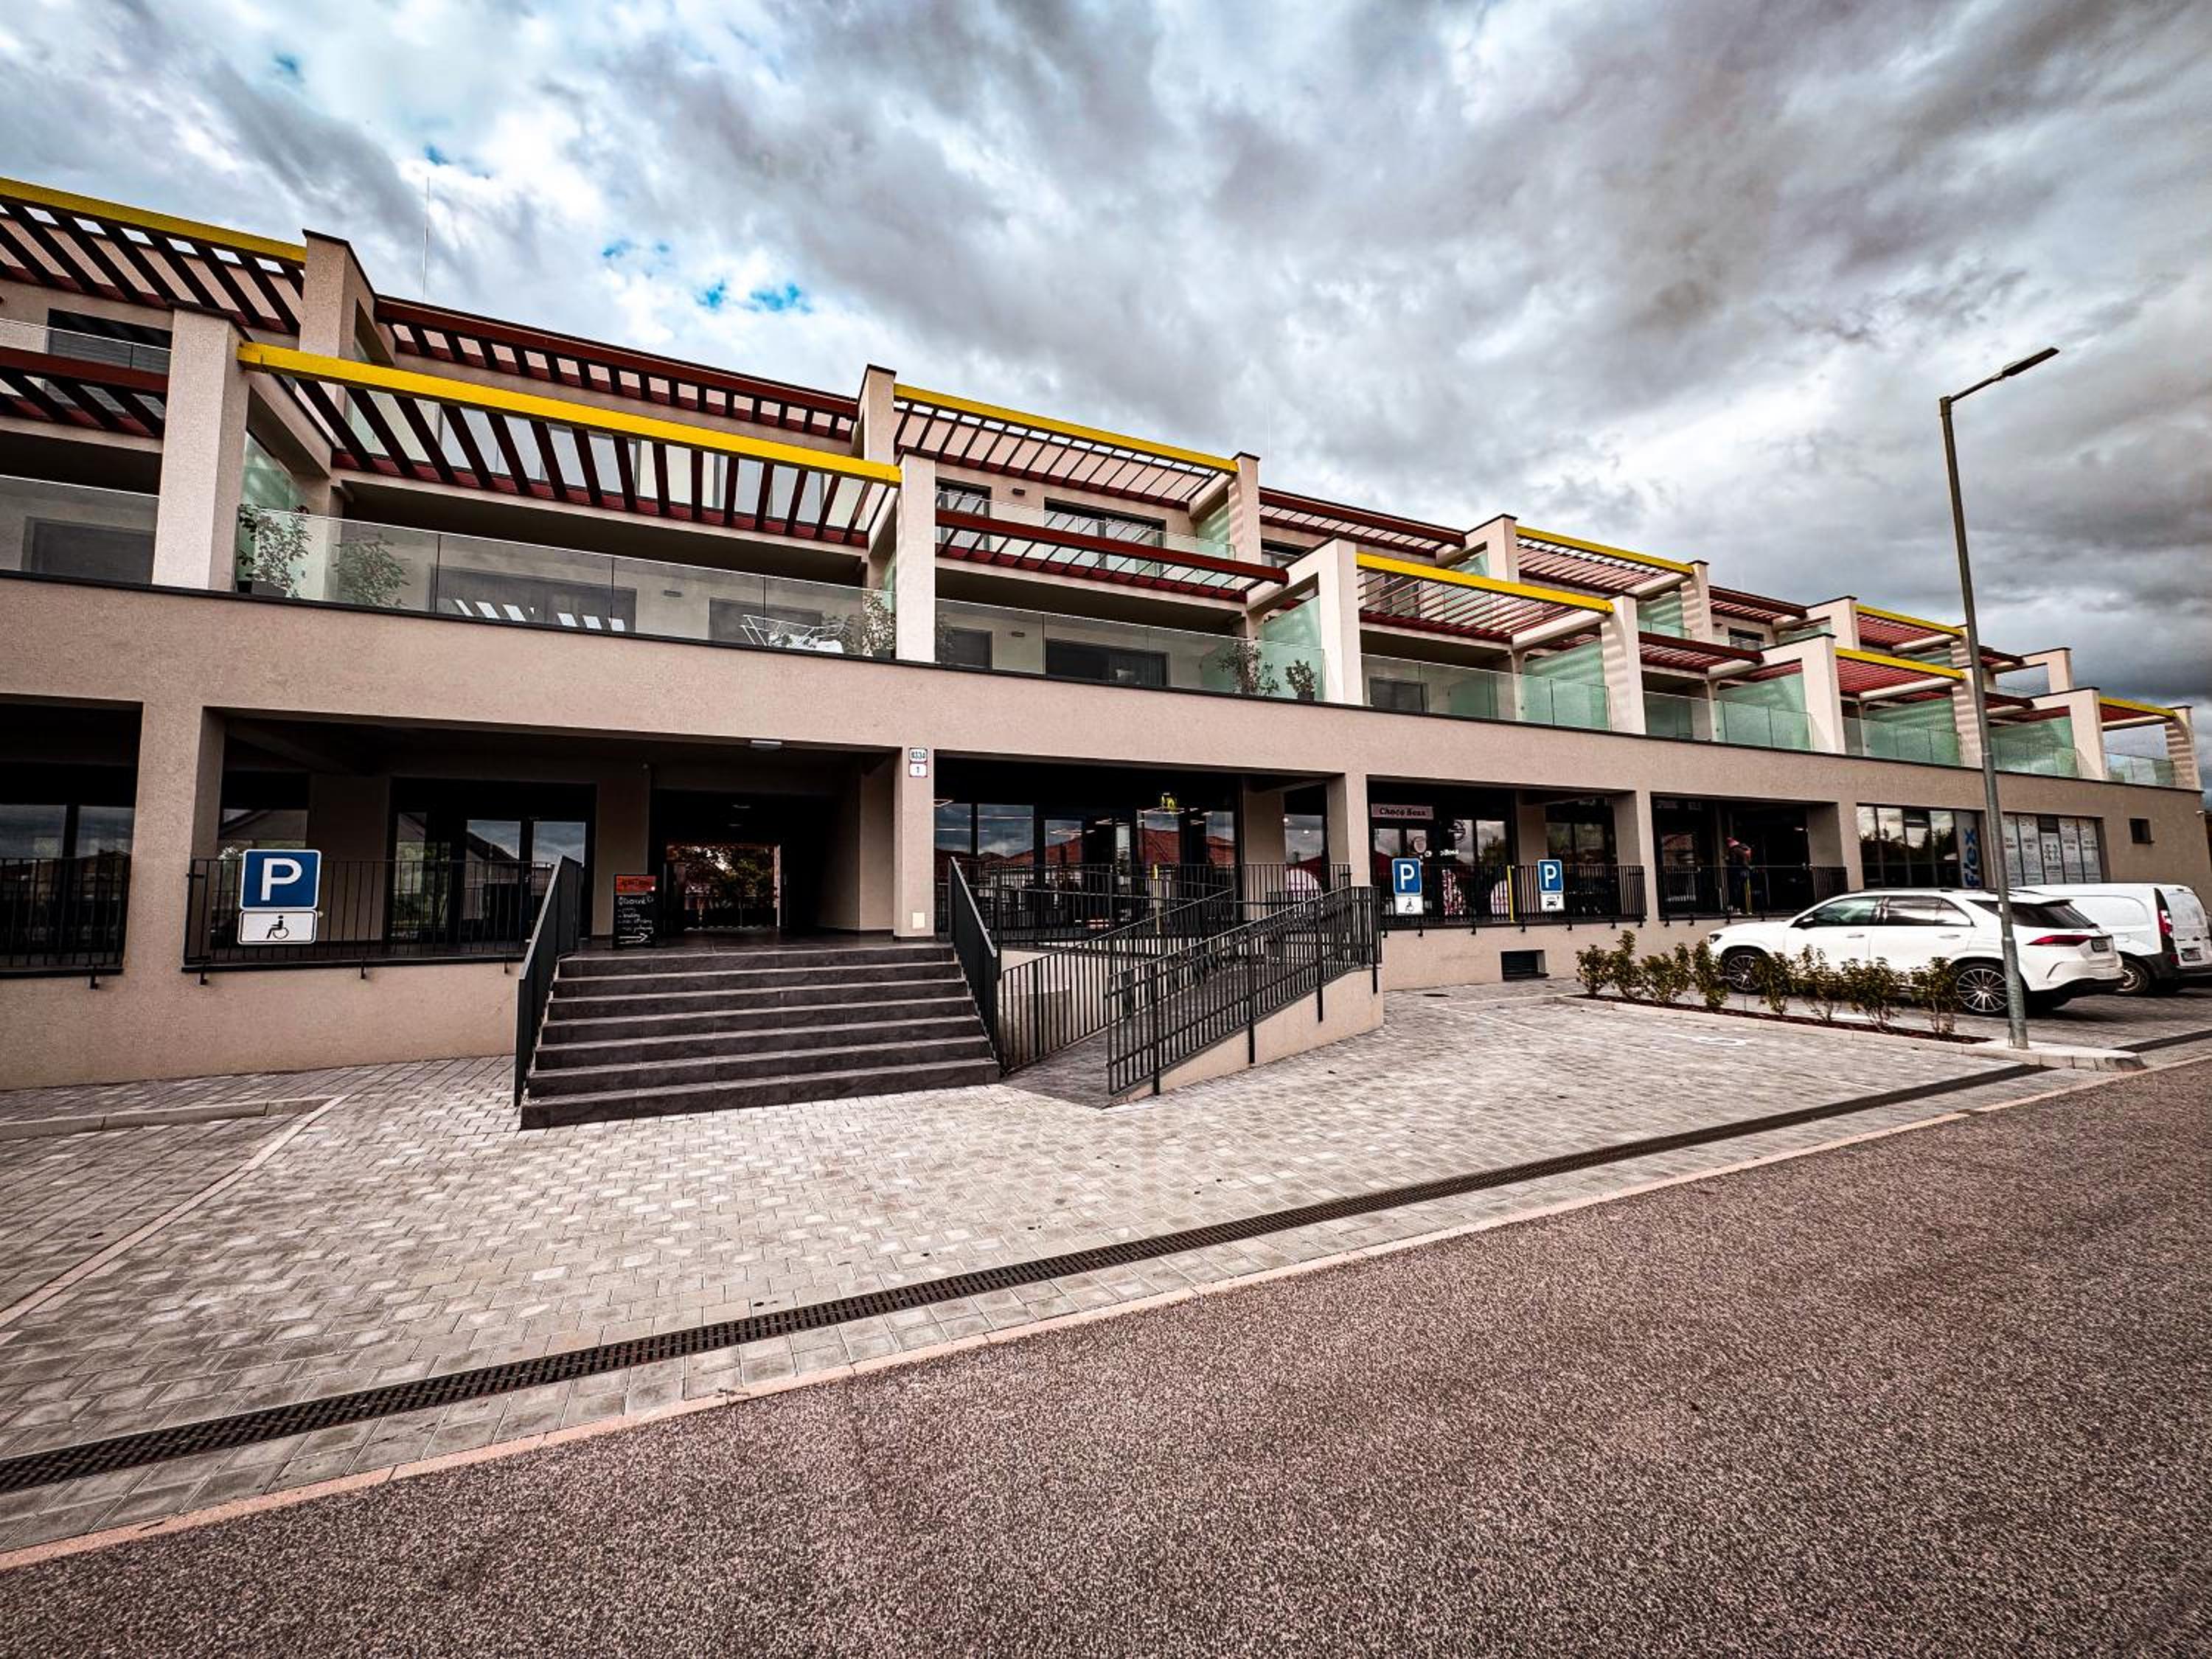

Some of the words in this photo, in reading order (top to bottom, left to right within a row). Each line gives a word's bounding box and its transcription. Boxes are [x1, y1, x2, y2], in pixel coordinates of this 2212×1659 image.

[260, 858, 302, 901] P
[1399, 863, 1415, 890] P
[1544, 864, 1557, 888] P
